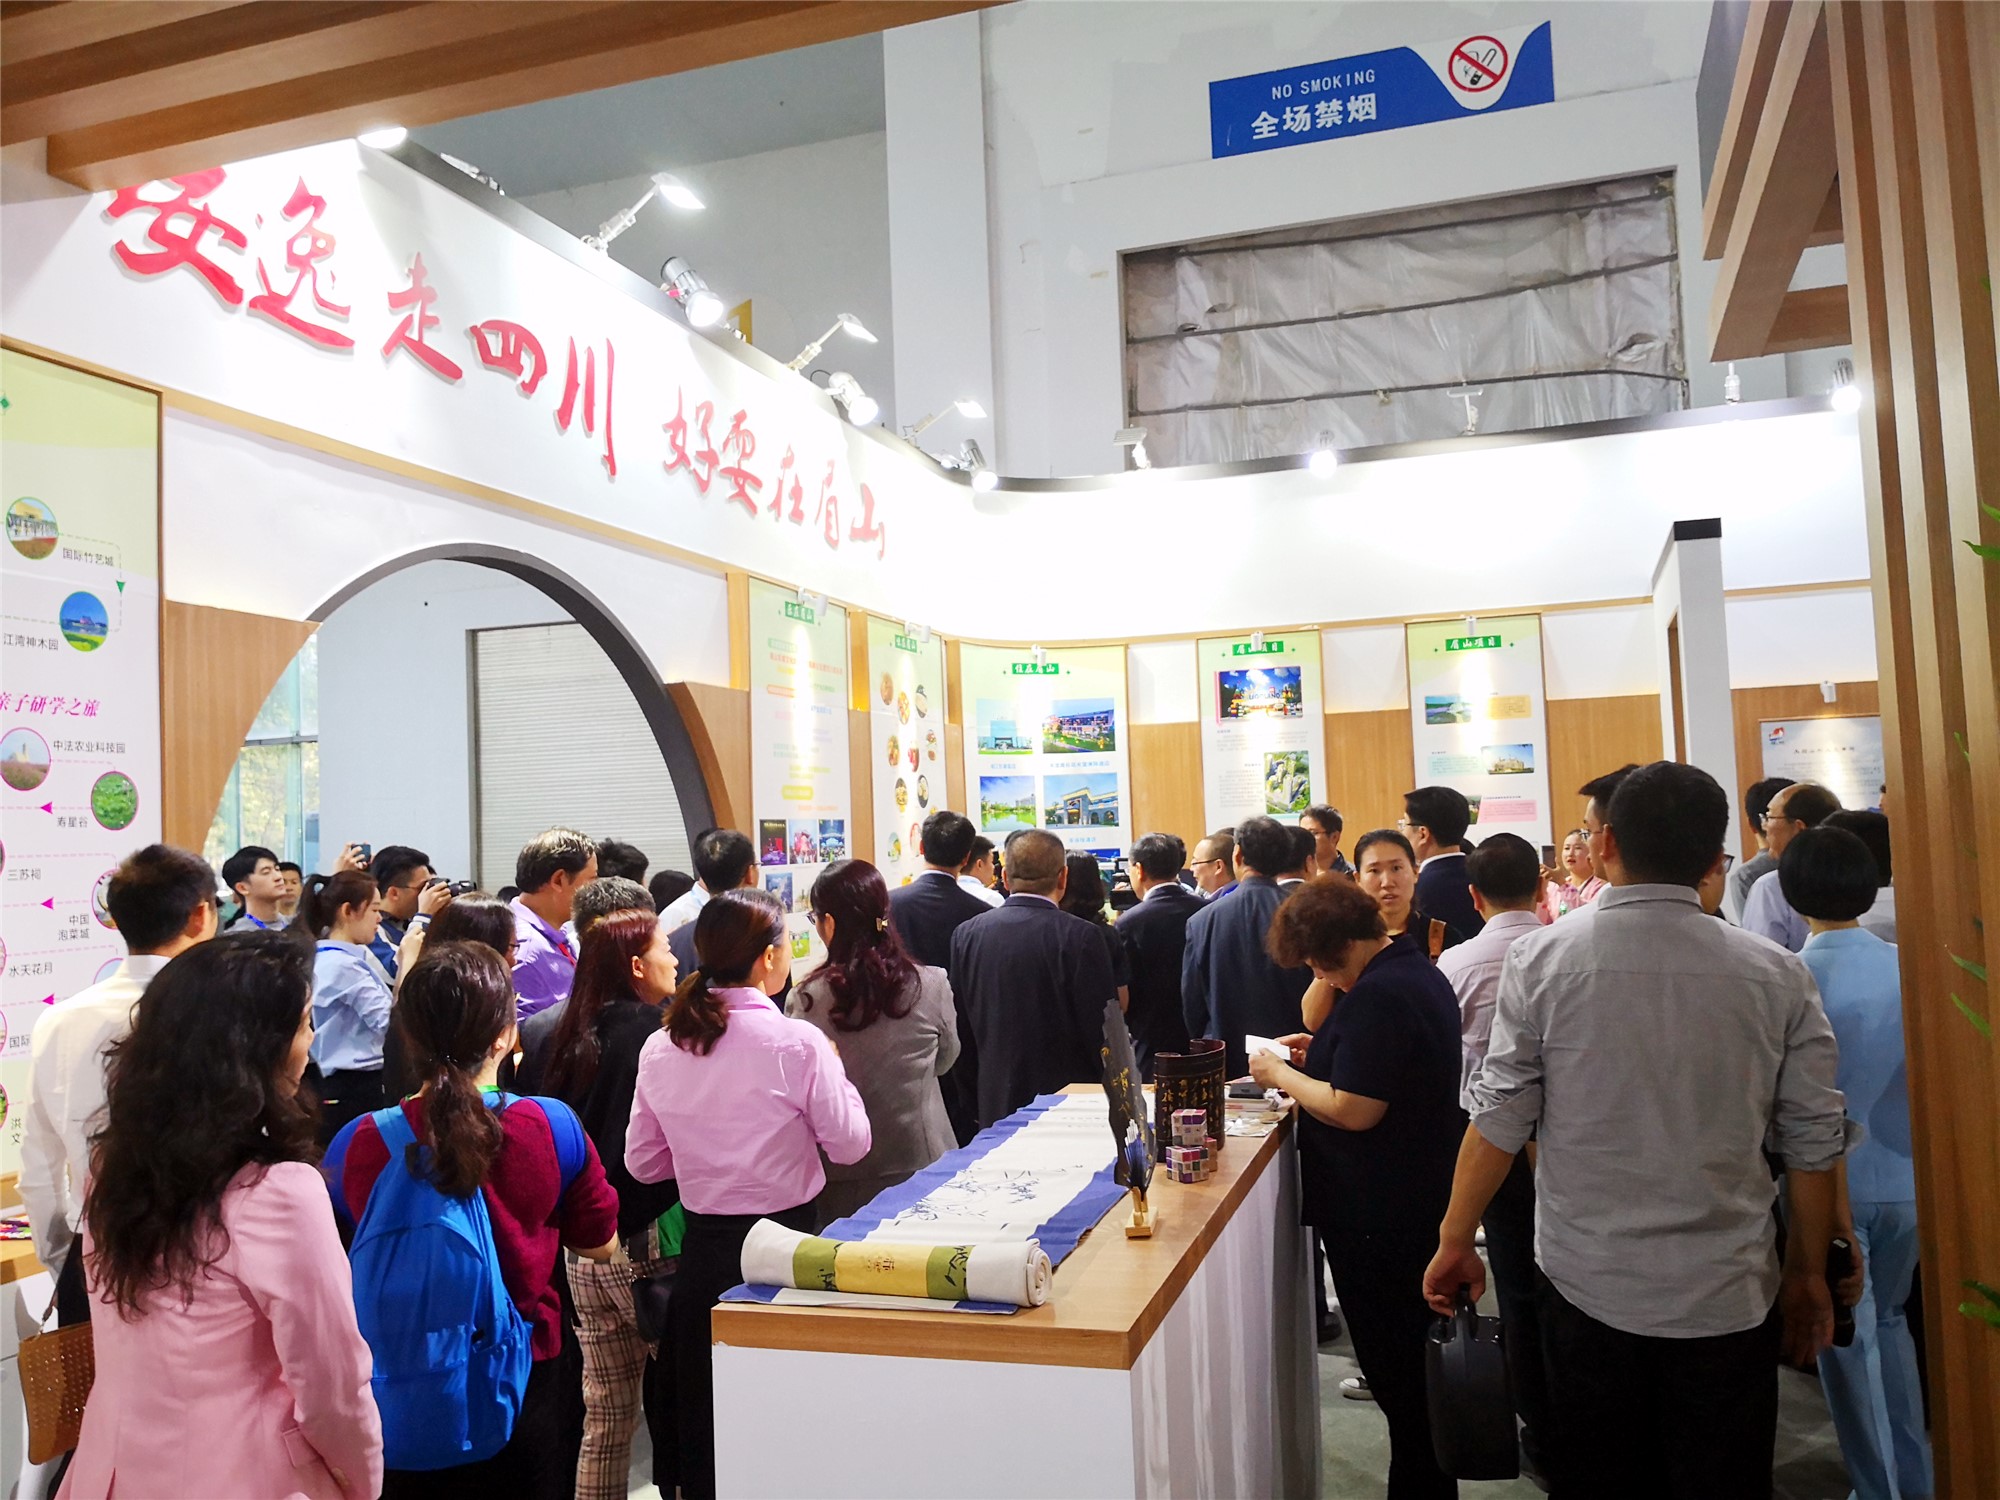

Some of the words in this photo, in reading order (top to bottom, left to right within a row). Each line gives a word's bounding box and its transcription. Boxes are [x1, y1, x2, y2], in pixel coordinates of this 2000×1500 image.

[1272, 85, 1292, 100] NO
[1300, 69, 1376, 95] SMOKING
[1250, 92, 1378, 141] 全场禁烟
[62, 547, 114, 567] 国际竹艺城
[3, 632, 58, 651] 江湾神木园
[1236, 642, 1278, 654] 眉项目
[1450, 636, 1496, 650] 眉山项目
[53, 740, 126, 754] 中法农业科技园
[57, 816, 88, 828] 寿星谷
[7, 868, 41, 881] 三苏祠
[69, 914, 90, 926] 中国
[58, 928, 90, 941] 泡菜城
[9, 962, 53, 977] 水天花月
